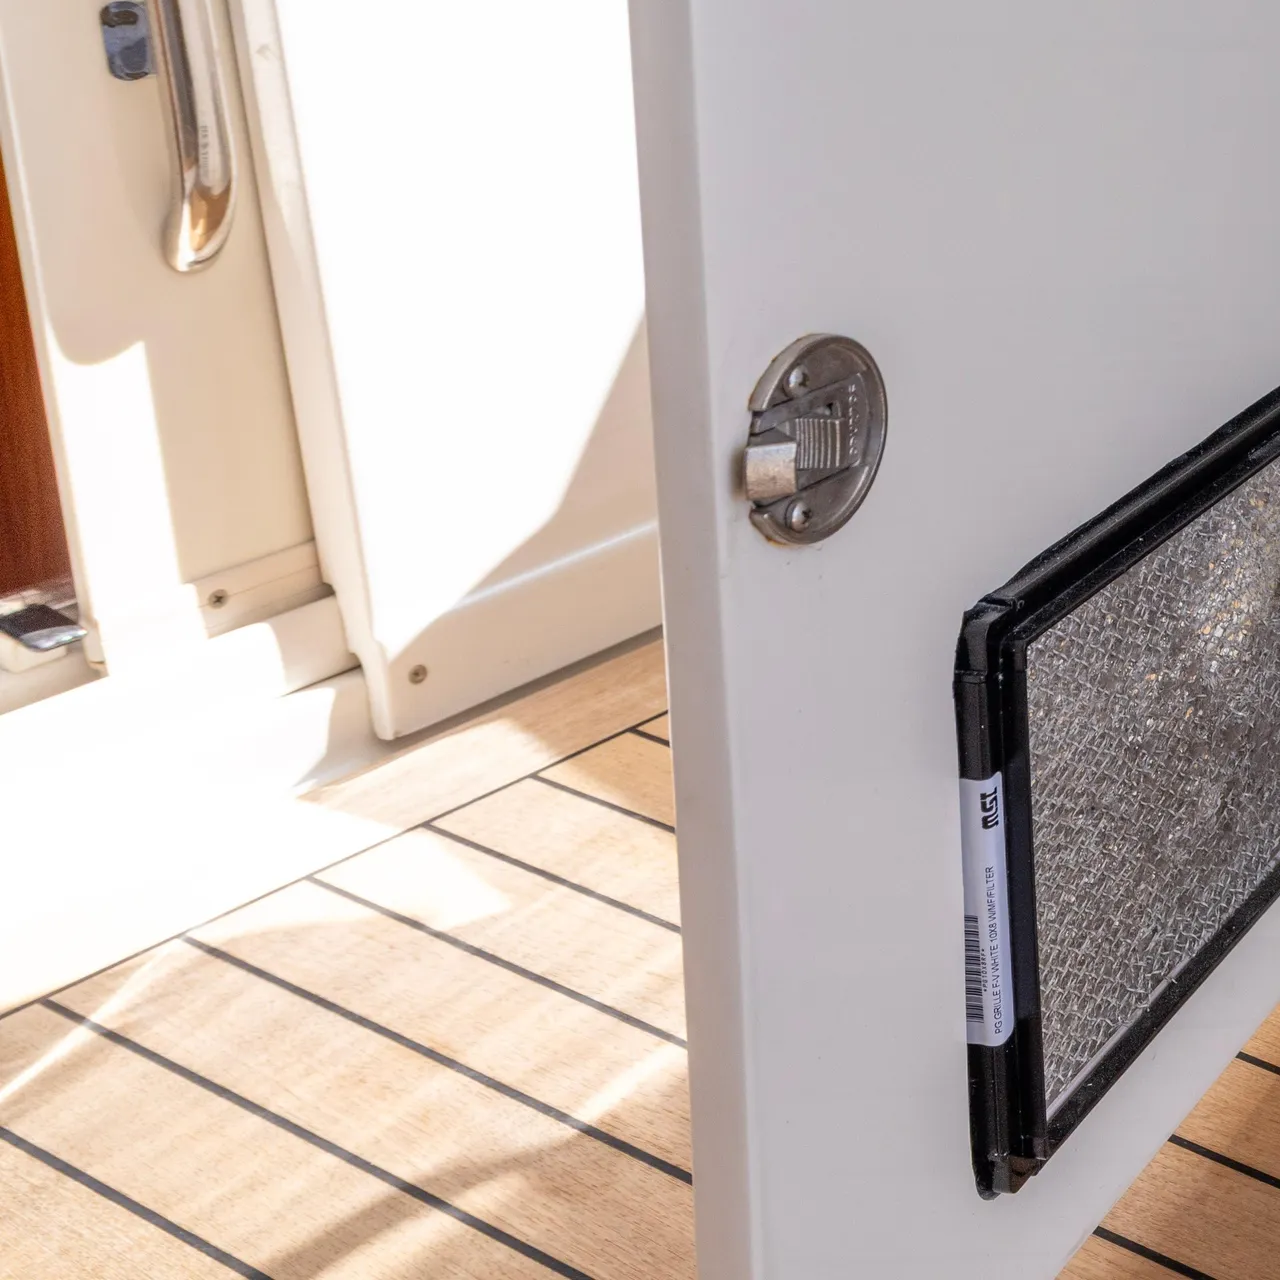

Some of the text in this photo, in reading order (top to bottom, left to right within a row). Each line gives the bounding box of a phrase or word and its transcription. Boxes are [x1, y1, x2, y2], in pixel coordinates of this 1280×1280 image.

[989, 923, 998, 943] 10X8
[990, 945, 999, 974] WHITE
[992, 974, 1001, 989] F-V
[993, 990, 1002, 1020] GRILLE
[995, 1020, 1002, 1034] PG
